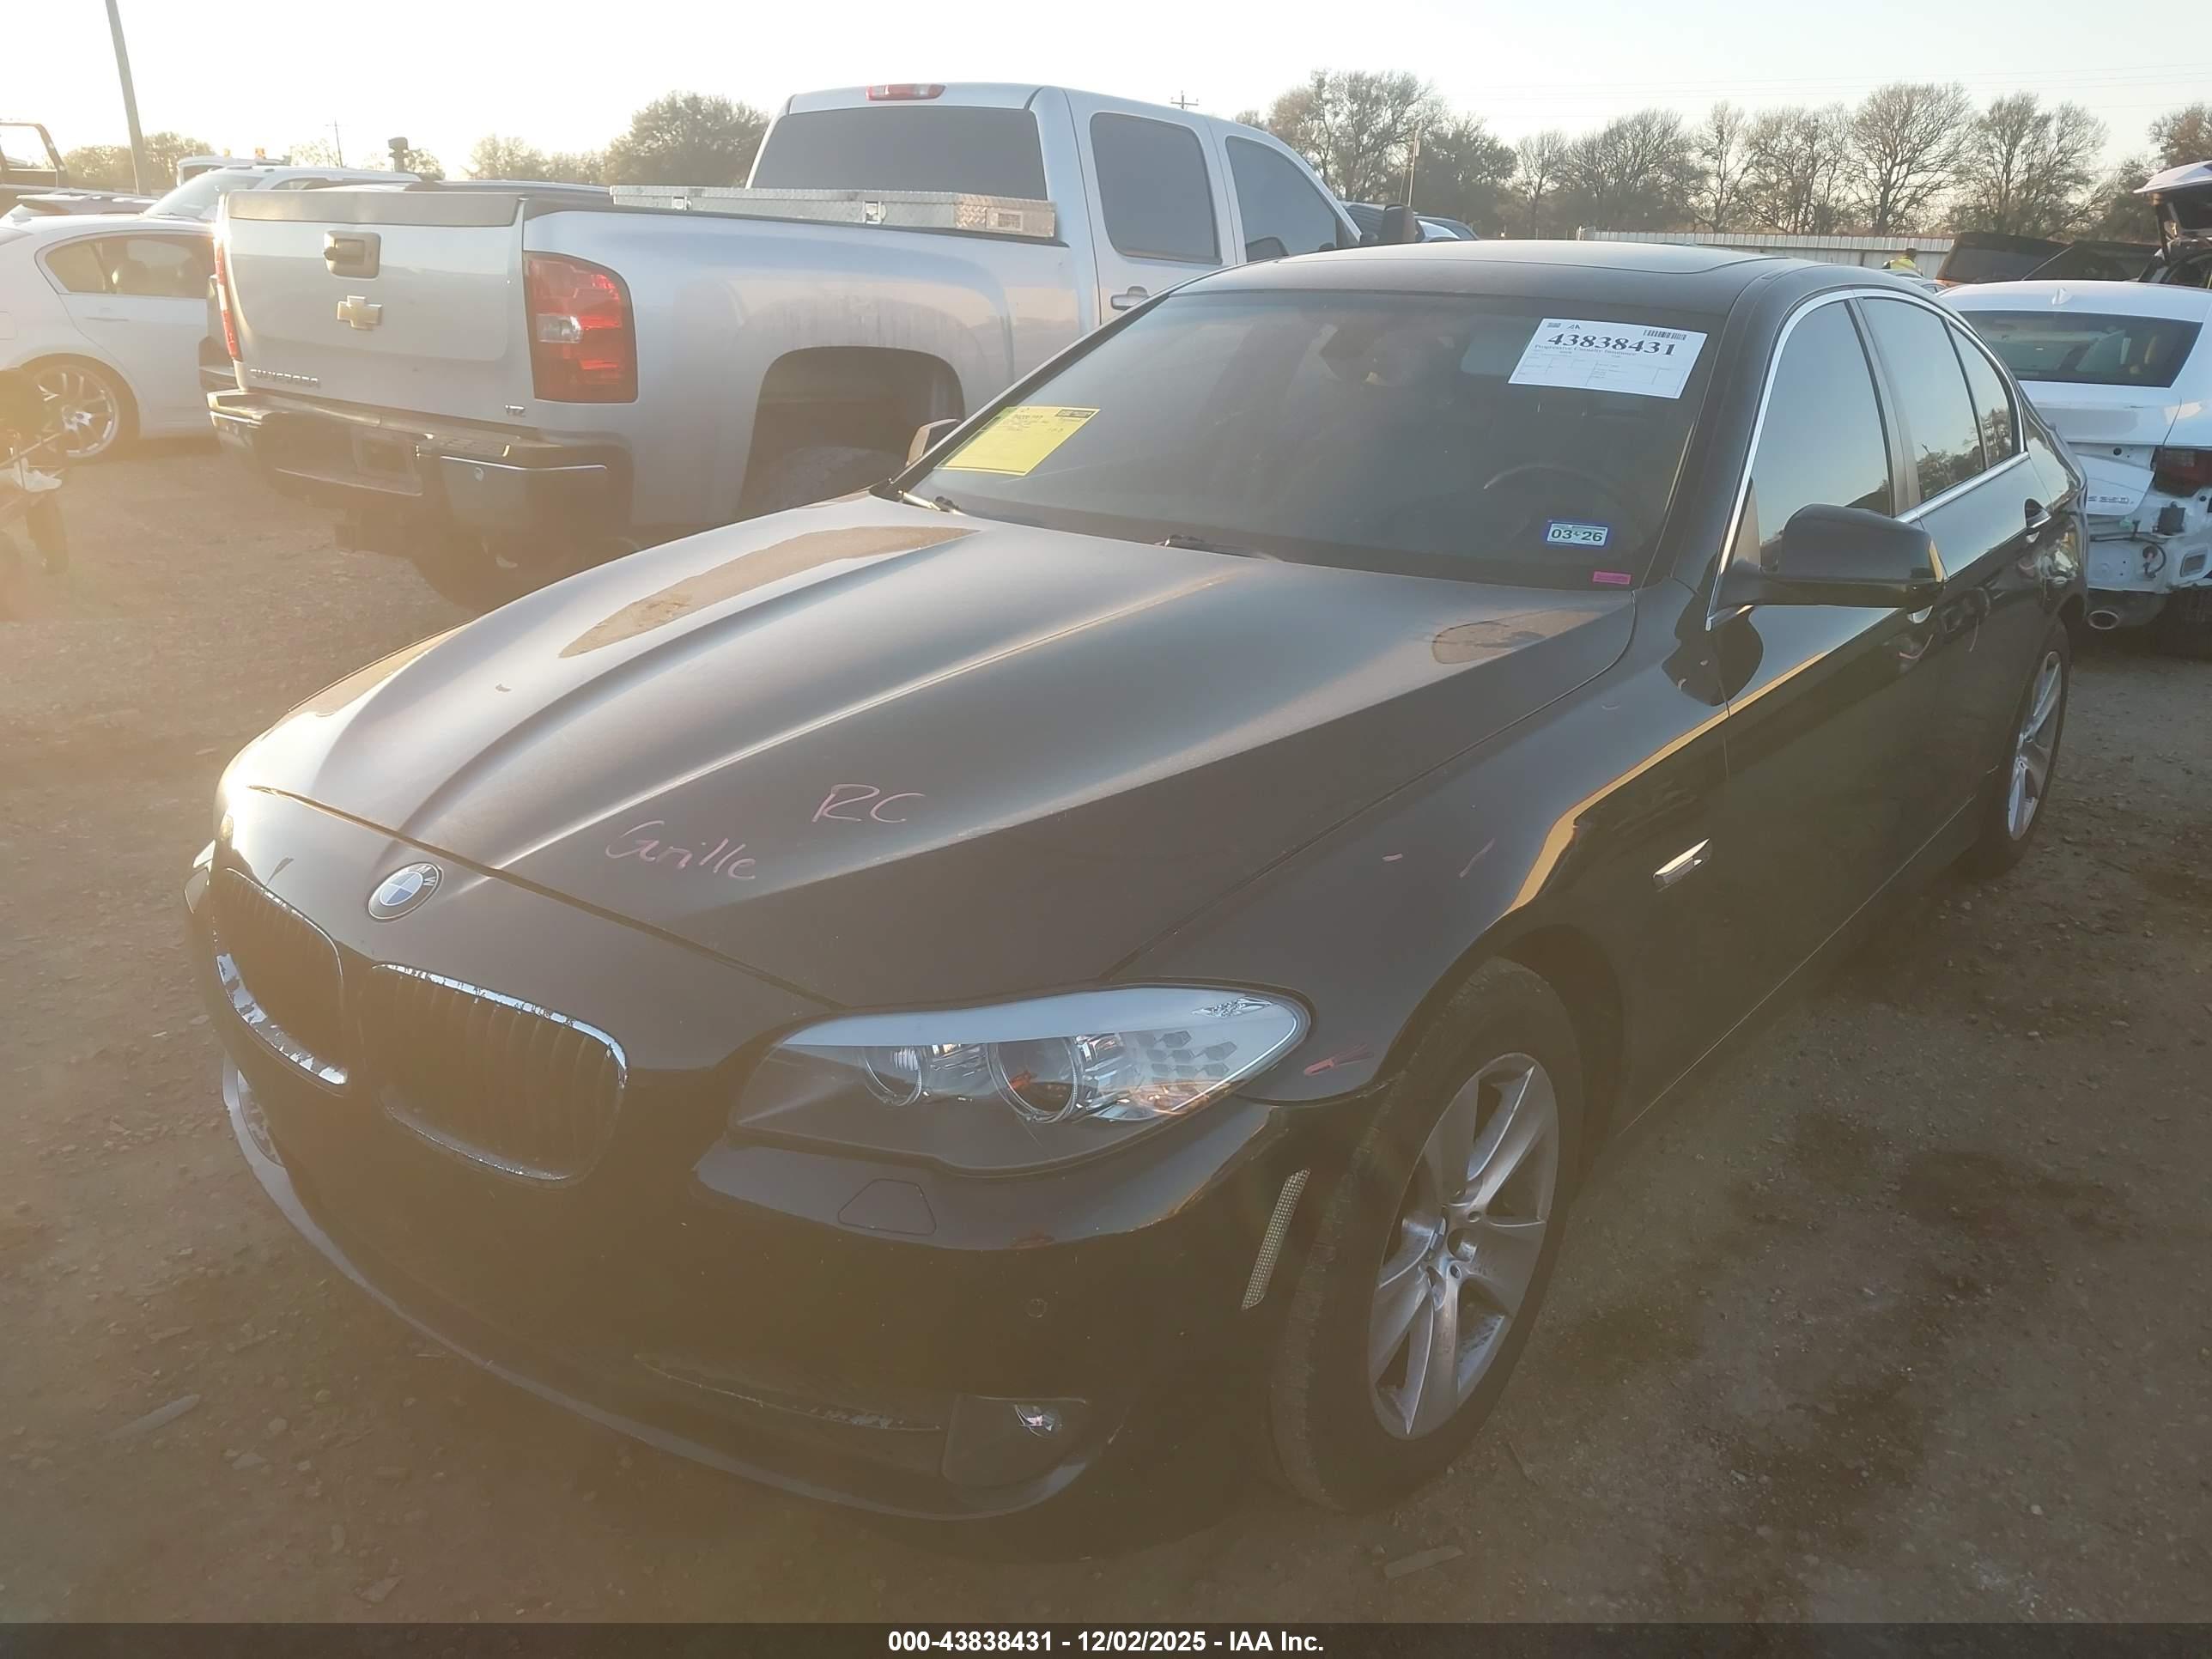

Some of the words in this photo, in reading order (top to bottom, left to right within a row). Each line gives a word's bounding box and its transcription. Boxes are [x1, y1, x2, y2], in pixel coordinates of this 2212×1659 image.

[1547, 332, 1676, 356] 43838431
[1551, 528, 1573, 539] 03
[1581, 531, 1603, 542] 26
[811, 783, 927, 823] RC
